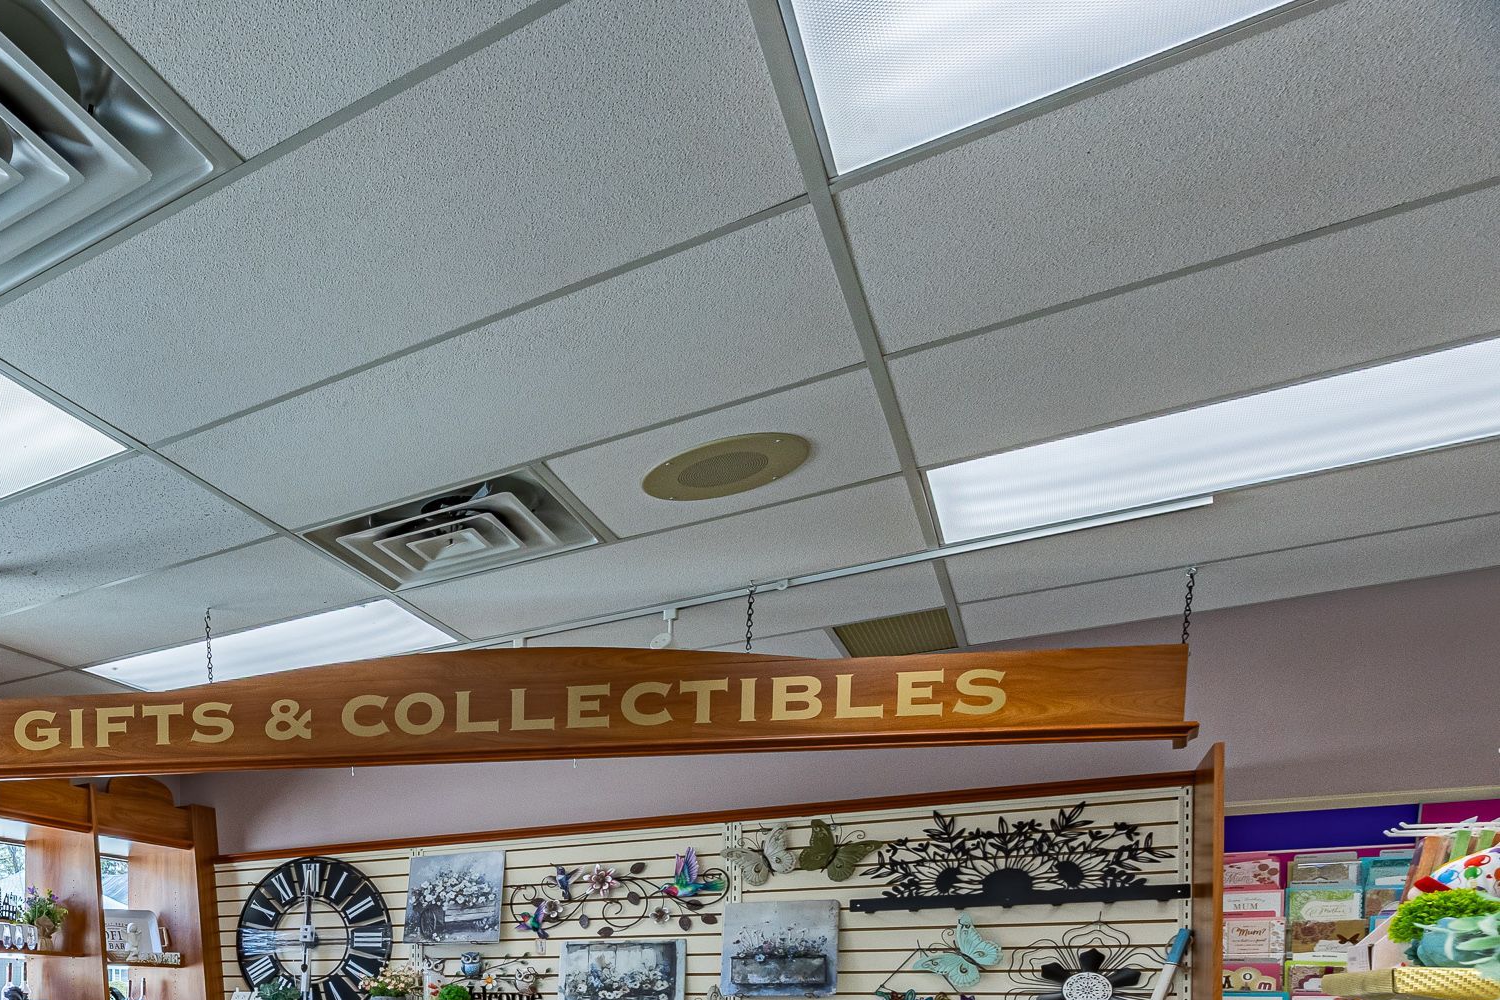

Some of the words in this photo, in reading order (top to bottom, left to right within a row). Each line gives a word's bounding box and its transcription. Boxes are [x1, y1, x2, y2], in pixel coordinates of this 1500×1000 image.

[14, 703, 234, 751] GIFTS
[265, 699, 312, 740] &
[341, 669, 1008, 738] COLLECTIBLES
